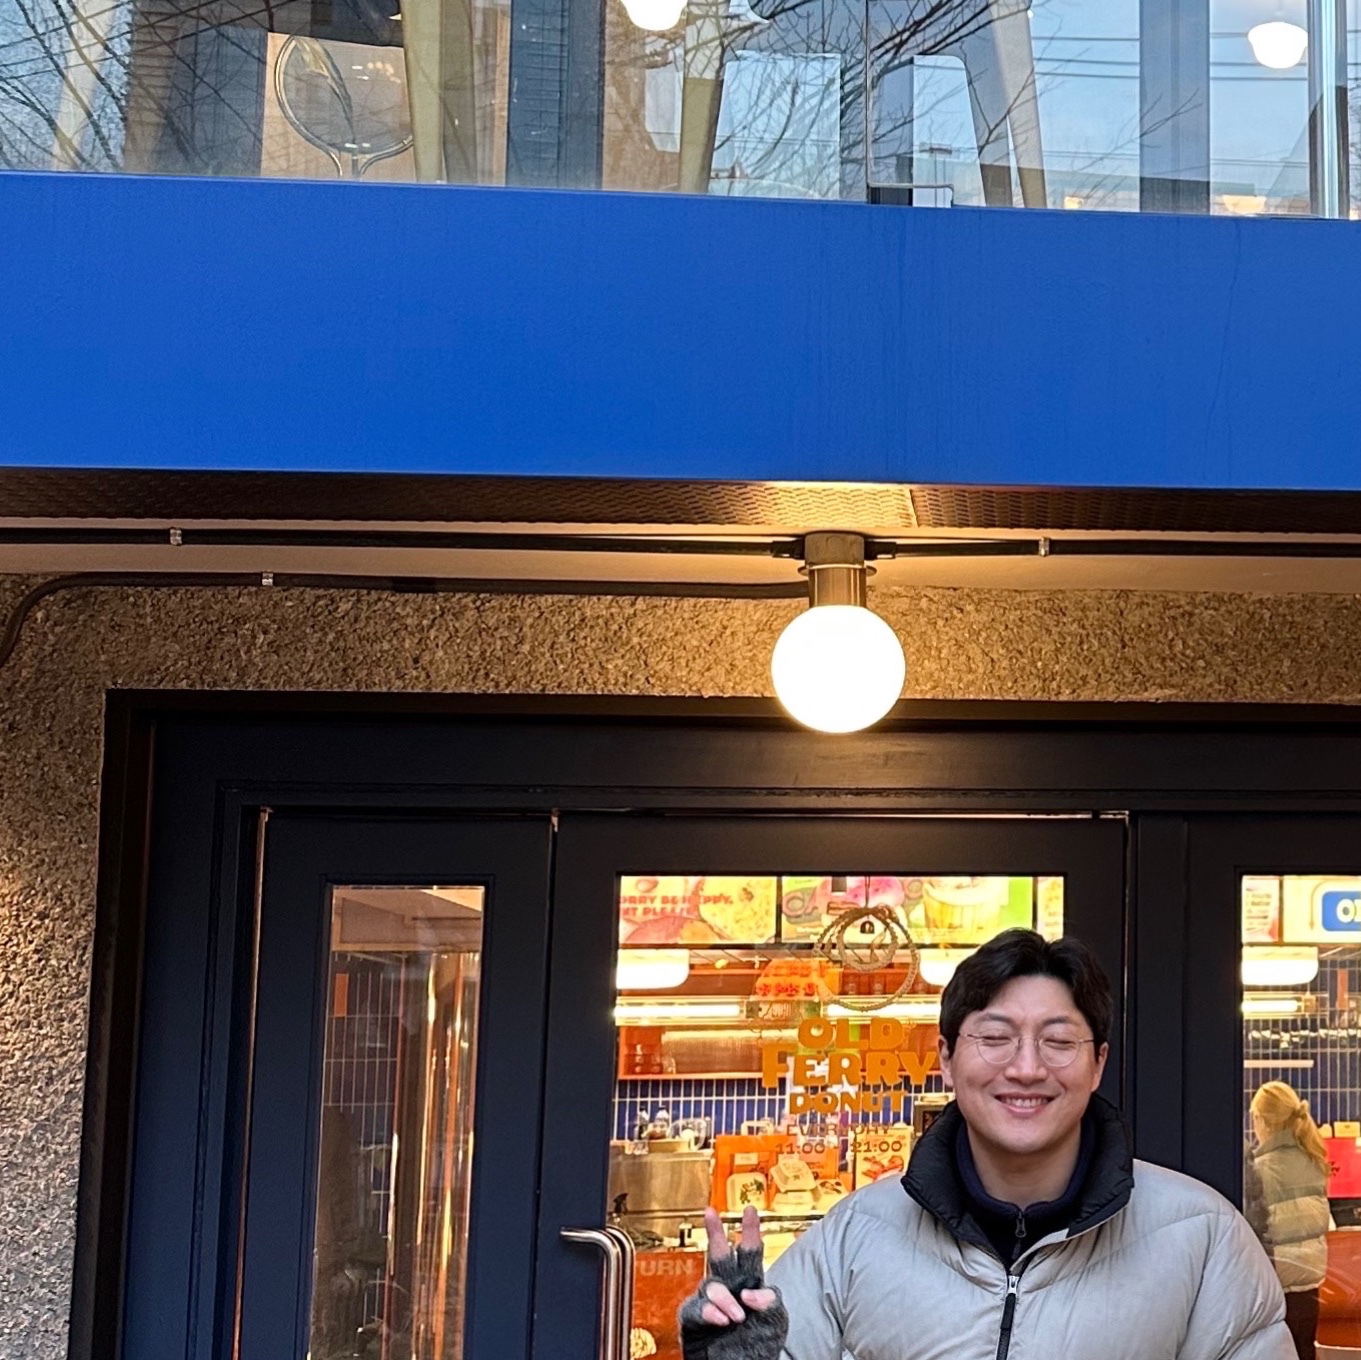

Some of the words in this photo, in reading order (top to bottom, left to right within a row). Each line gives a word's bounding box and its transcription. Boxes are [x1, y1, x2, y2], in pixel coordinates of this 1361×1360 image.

[762, 1043, 937, 1088] FERRY
[789, 1091, 907, 1115] DONUT
[775, 1142, 826, 1155] 11:00
[850, 1140, 903, 1154] 21:00
[636, 1258, 694, 1277] URN
